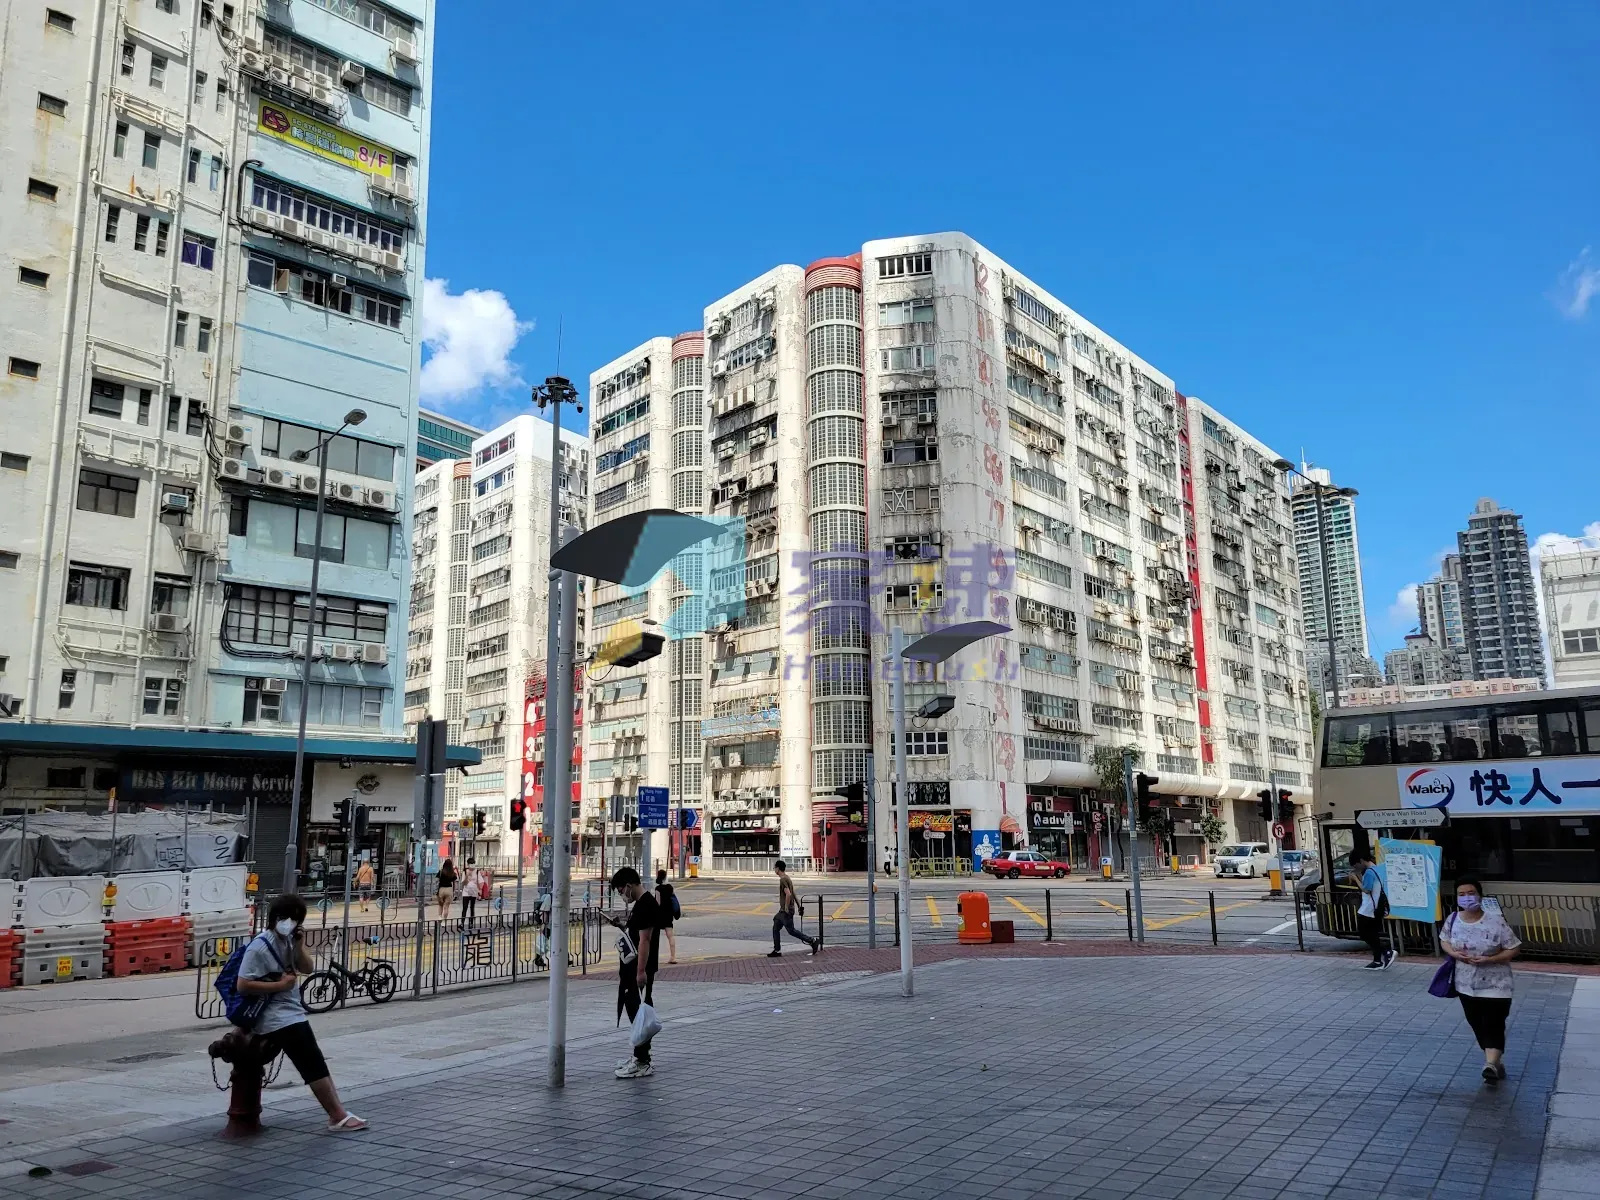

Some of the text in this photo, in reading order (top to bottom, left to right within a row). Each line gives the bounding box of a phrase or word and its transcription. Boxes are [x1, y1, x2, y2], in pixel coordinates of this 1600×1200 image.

[359, 145, 388, 169] 8/F
[526, 736, 536, 762] 3
[203, 772, 247, 791] Motor
[524, 772, 535, 797] 2
[1408, 784, 1449, 795] Walch
[723, 819, 762, 828] adiva
